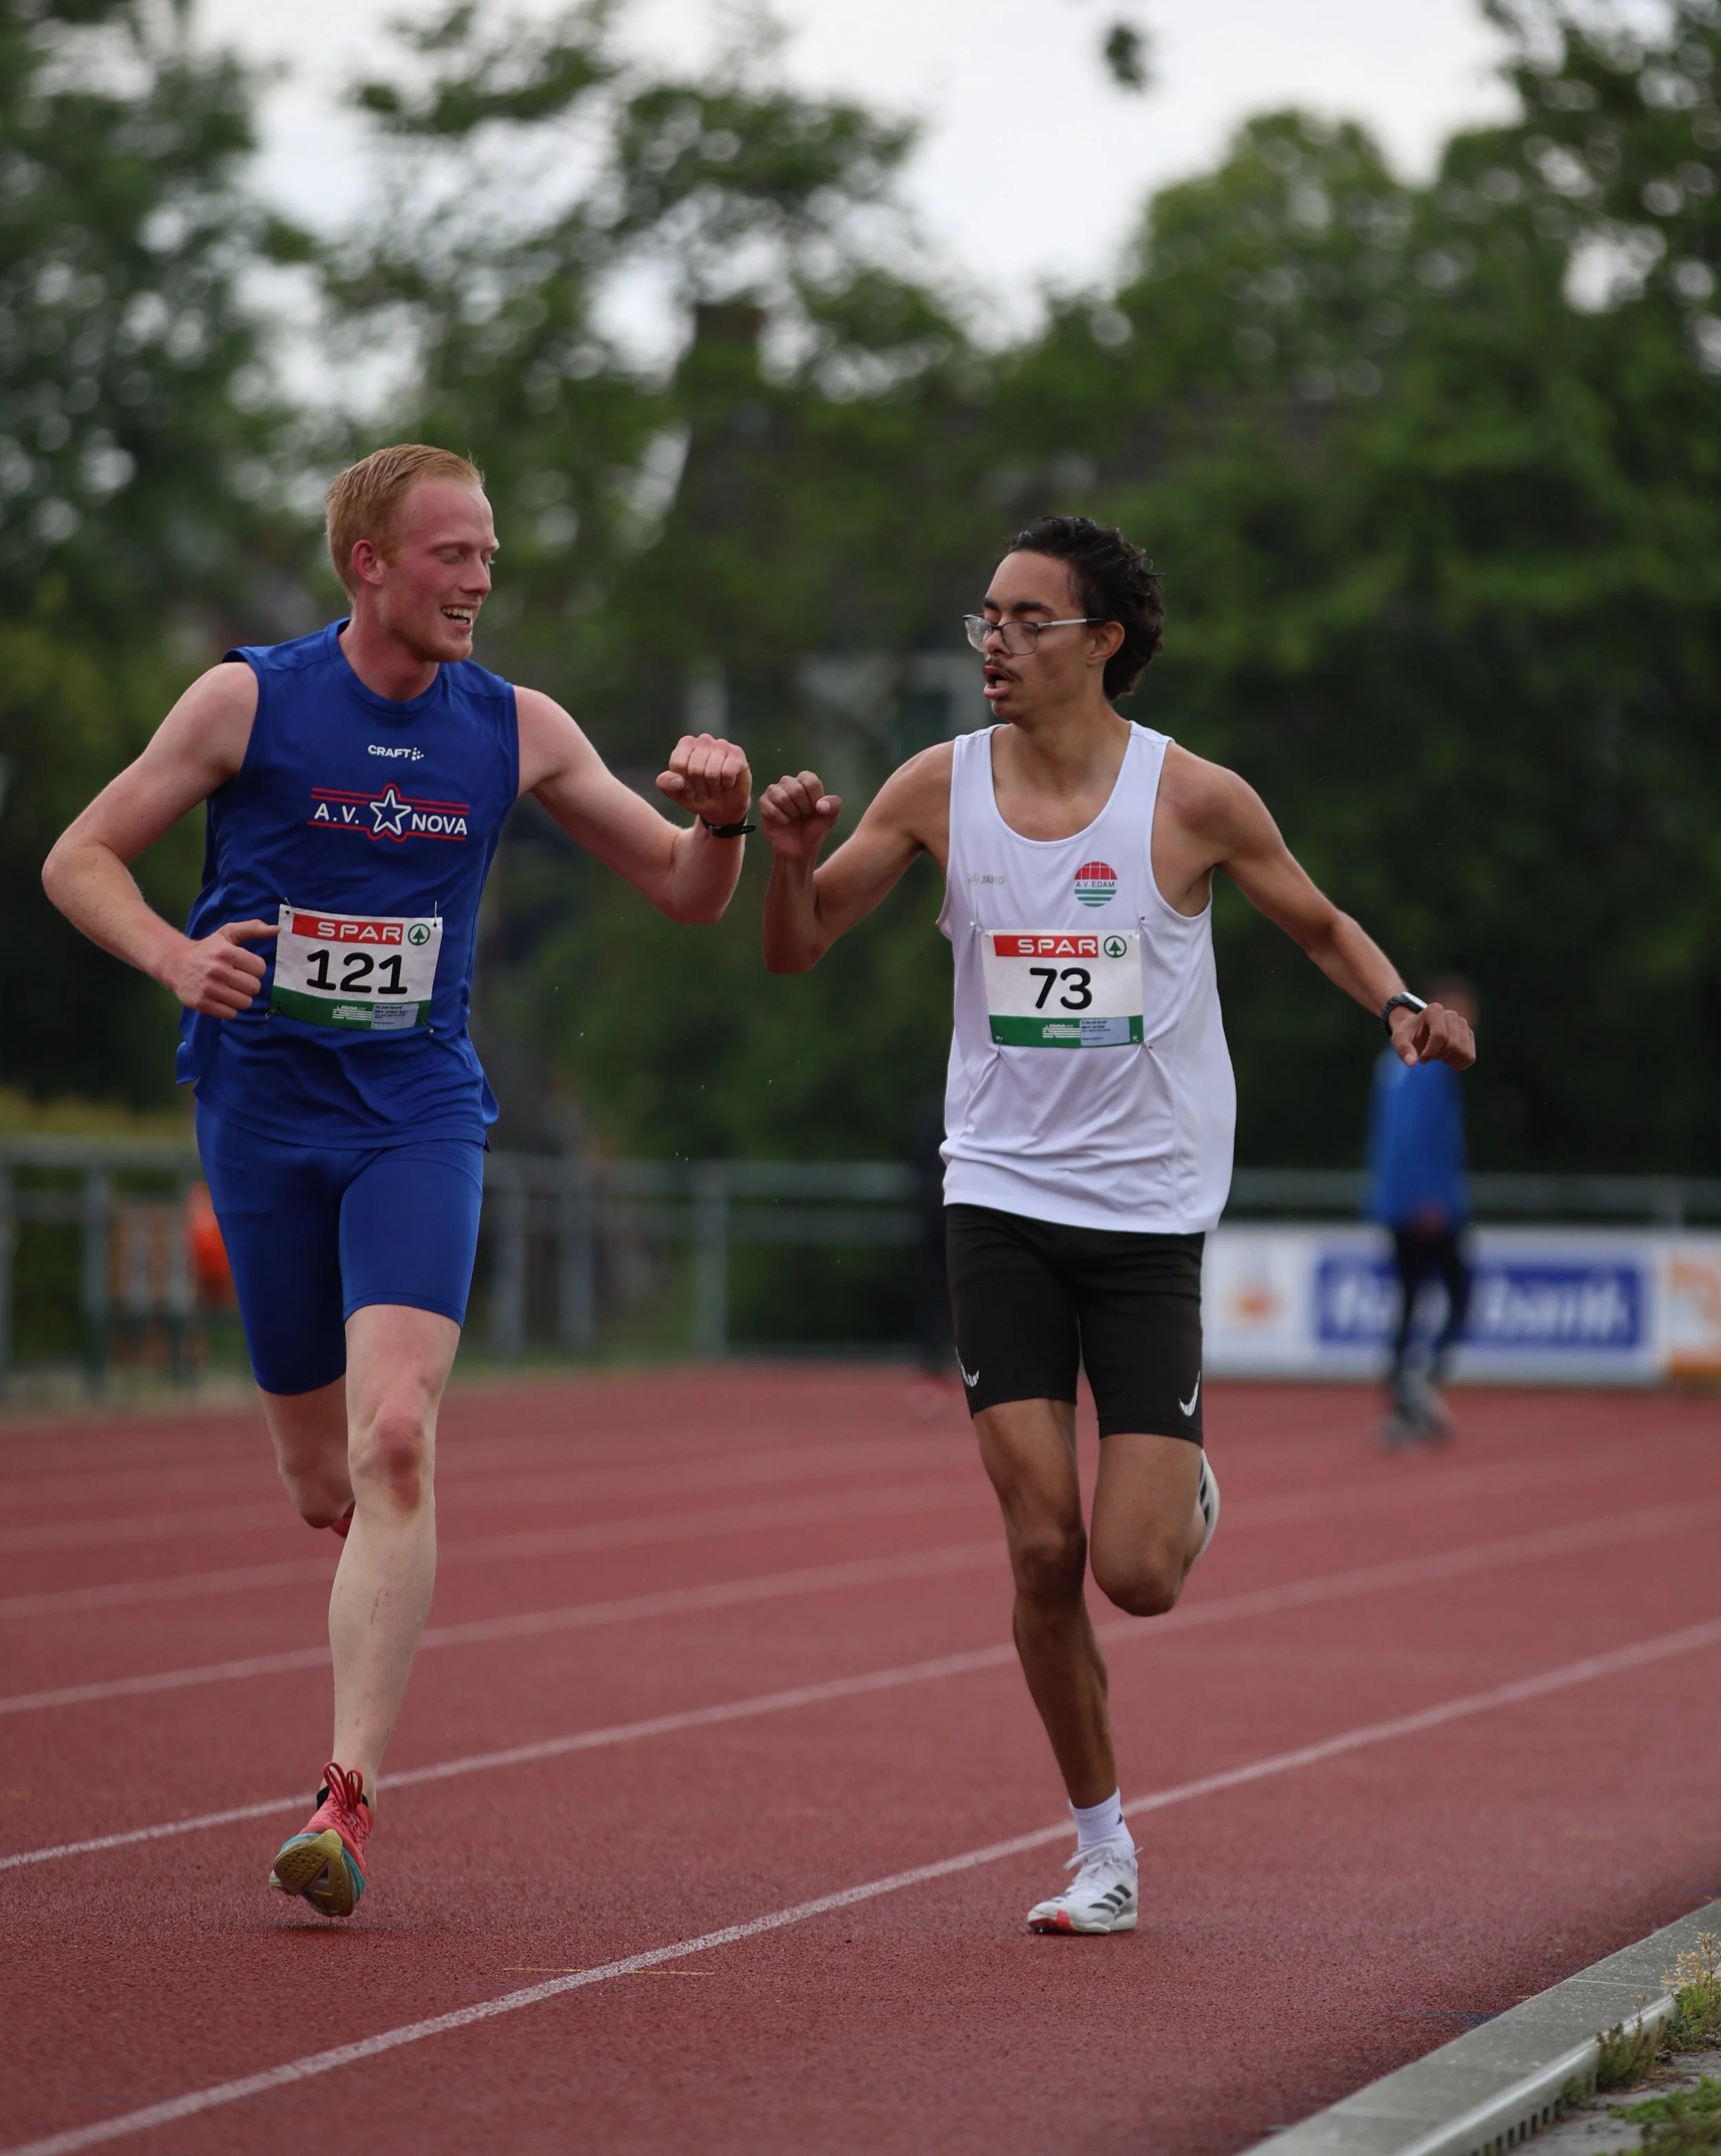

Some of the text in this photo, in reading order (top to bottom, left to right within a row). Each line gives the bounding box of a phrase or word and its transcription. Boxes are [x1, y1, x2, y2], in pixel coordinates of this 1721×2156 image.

[368, 745, 411, 758] CRAFT
[412, 814, 467, 835] NOVA
[317, 921, 401, 942] SPAR
[1019, 940, 1096, 954] SPAR
[307, 949, 408, 994] 121
[1029, 967, 1092, 1010] 73
